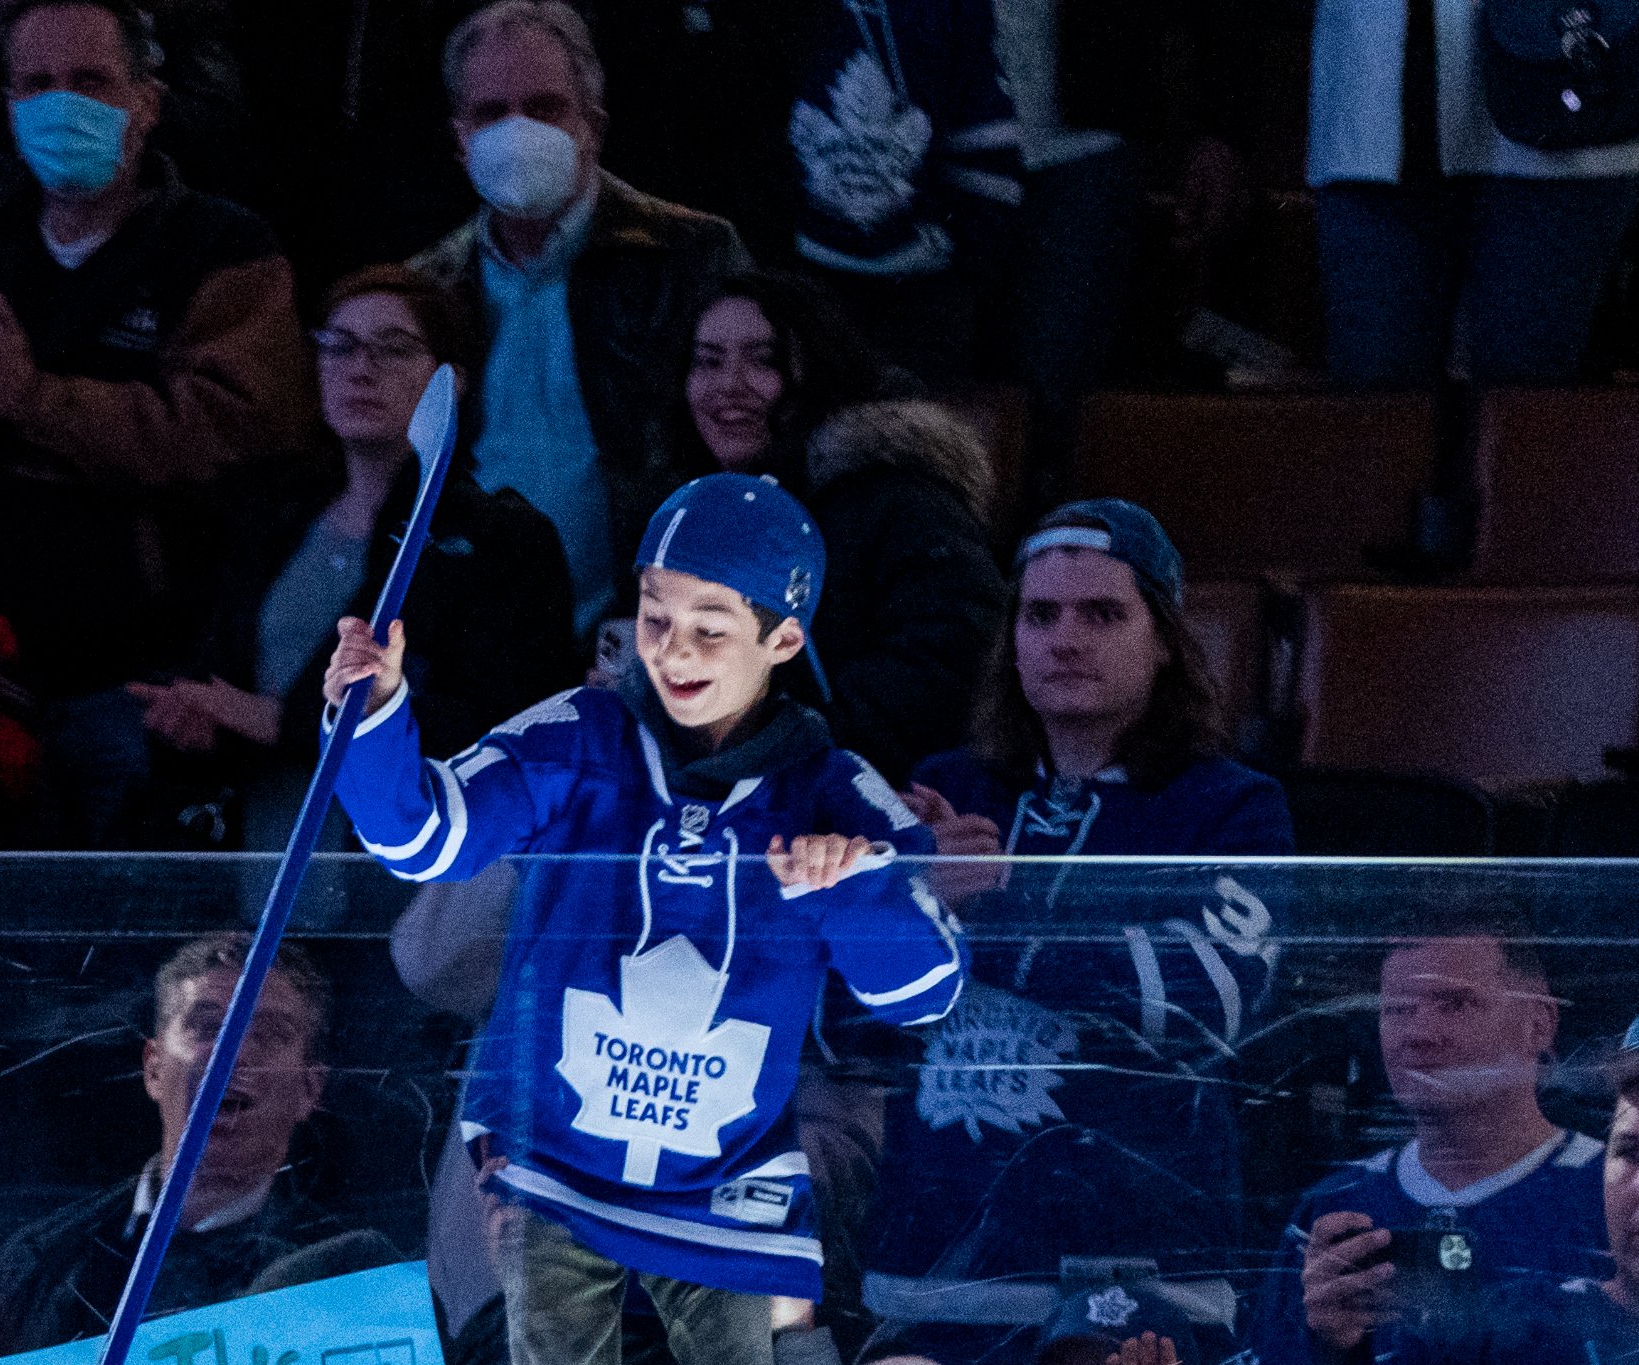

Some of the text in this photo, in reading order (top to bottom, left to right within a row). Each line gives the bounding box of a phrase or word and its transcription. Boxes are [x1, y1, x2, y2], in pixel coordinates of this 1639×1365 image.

[594, 1031, 727, 1080] TORONTO
[607, 1065, 701, 1104] MAPLE
[609, 1094, 690, 1131] LEAFS
